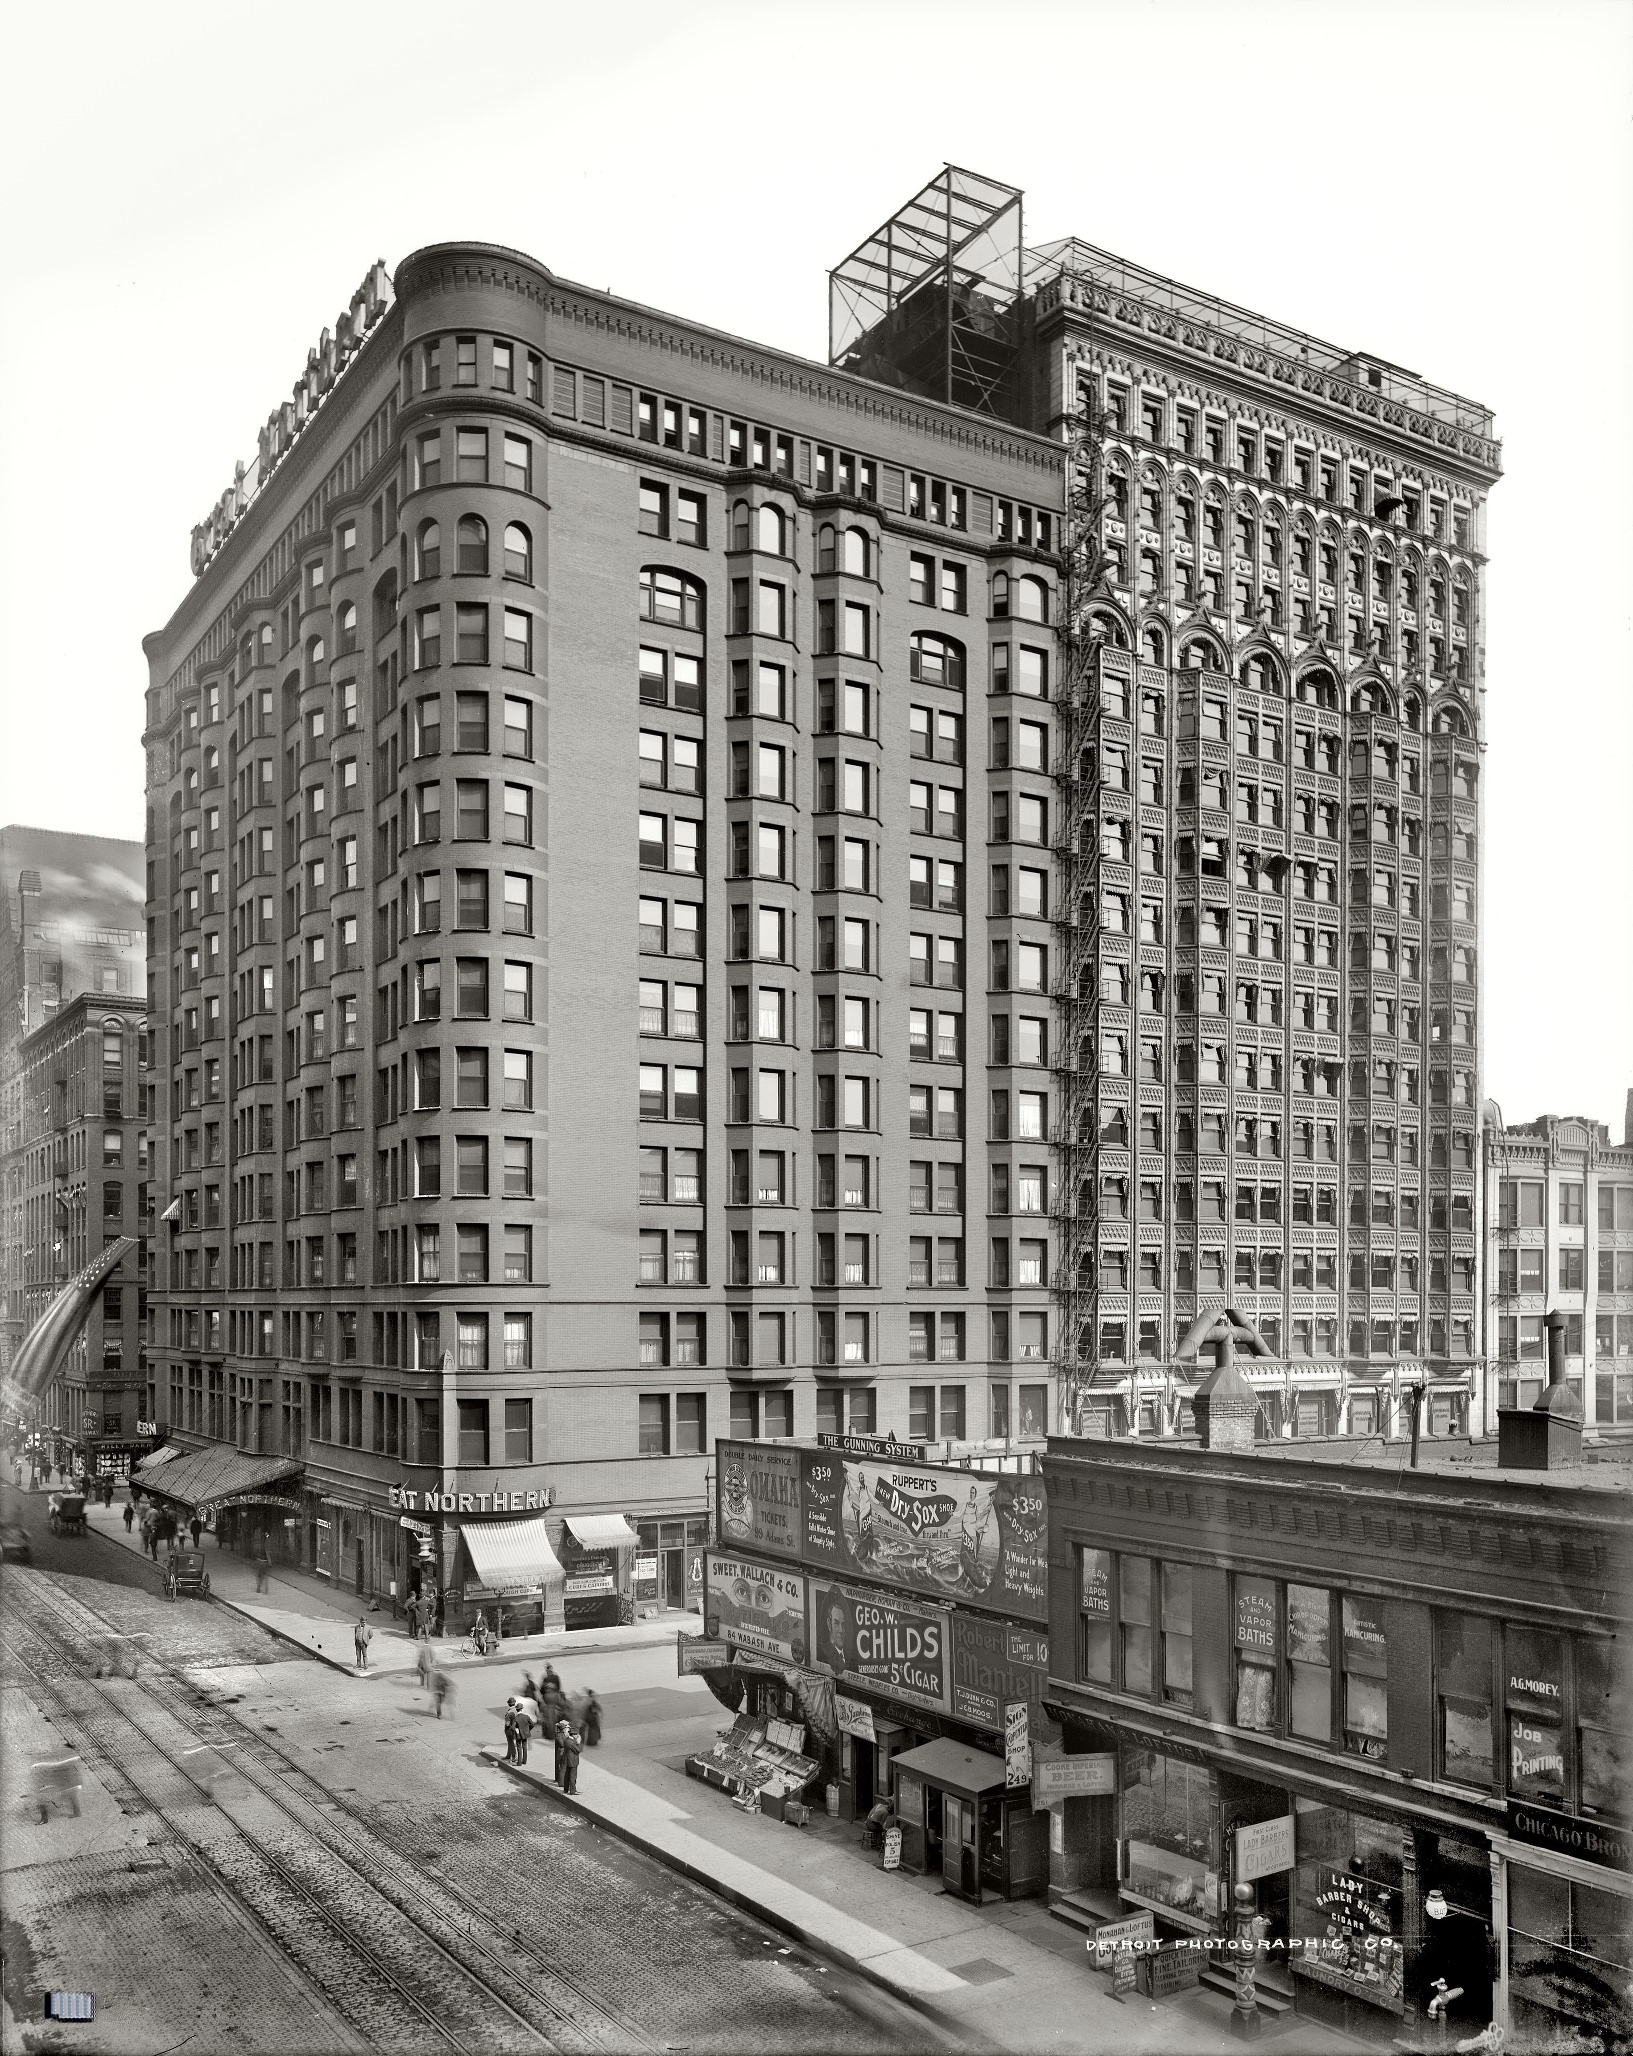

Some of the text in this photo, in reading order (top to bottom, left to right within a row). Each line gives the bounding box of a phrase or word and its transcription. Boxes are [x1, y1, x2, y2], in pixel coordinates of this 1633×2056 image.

[823, 1435, 918, 1457] THE GUNNING SYSTEM
[725, 1451, 791, 1465] DOUBLE DAILY SERVICE
[750, 1471, 799, 1508] OMAHA
[892, 1474, 937, 1492] RUPPERT'S
[199, 1495, 300, 1515] GREAT NORTHERN
[424, 1487, 553, 1512] NORTHERN
[940, 1503, 954, 1512] SHOE
[890, 1490, 940, 1532] Dry-Sox
[755, 1527, 763, 1538] 99
[766, 1530, 784, 1545] Adams
[1010, 1551, 1028, 1565] Wonder
[740, 1565, 775, 1587] WALLACH
[777, 1580, 783, 1592] &
[786, 1581, 798, 1598] CO.
[1005, 1565, 1030, 1579] Light and
[1005, 1579, 1022, 1596] Heavy
[1084, 1586, 1107, 1597] VAPOR
[1082, 1596, 1109, 1611] BATHS
[1239, 1596, 1272, 1612] STEAM
[856, 1605, 898, 1625] GEO. W.
[1240, 1615, 1272, 1628] VAPOR
[1353, 1619, 1376, 1629] ARTISTIC
[956, 1619, 1006, 1652] Robert
[1238, 1627, 1274, 1646] BATHS
[1289, 1624, 1328, 1642] MANICURING.
[1344, 1627, 1387, 1644] MANICURING.
[738, 1633, 764, 1649] WABASH
[768, 1641, 782, 1654] AVE.
[857, 1627, 939, 1659] CHILDS
[1012, 1644, 1030, 1654] LIMIT
[904, 1662, 939, 1693] CIGAR
[957, 1649, 1043, 1702] Mantell
[1510, 1677, 1559, 1697] A.G.MOREY.
[986, 1699, 996, 1708] CO.
[1006, 1707, 1026, 1727] SIGN
[1048, 1706, 1117, 1736] MONAHAN
[1513, 1723, 1542, 1743] JOB
[1008, 1745, 1025, 1755] SHOP
[1072, 1761, 1105, 1770] IMPERIAL
[1512, 1746, 1564, 1780] PRINTING
[1008, 1772, 1027, 1786] 249
[1052, 1771, 1103, 1781] BEER.
[1265, 1824, 1279, 1832] CLASS
[1515, 1812, 1581, 1847] CHICAGO
[1243, 1829, 1289, 1850] LADY BARBERS
[1245, 1843, 1287, 1872] CIGARS
[1332, 1874, 1363, 1894] LADY
[1316, 1891, 1381, 1925] BARBER SHOP
[1344, 1906, 1351, 1915] &
[1098, 1927, 1125, 1940] MONAHAN
[1130, 1919, 1152, 1932] LOFTUS
[1332, 1912, 1364, 1931] CIGARS
[1155, 1954, 1208, 1974] FINE TAILORING
[1161, 1953, 1179, 1963] QUICK
[1155, 1970, 1177, 1981] CLEANING
